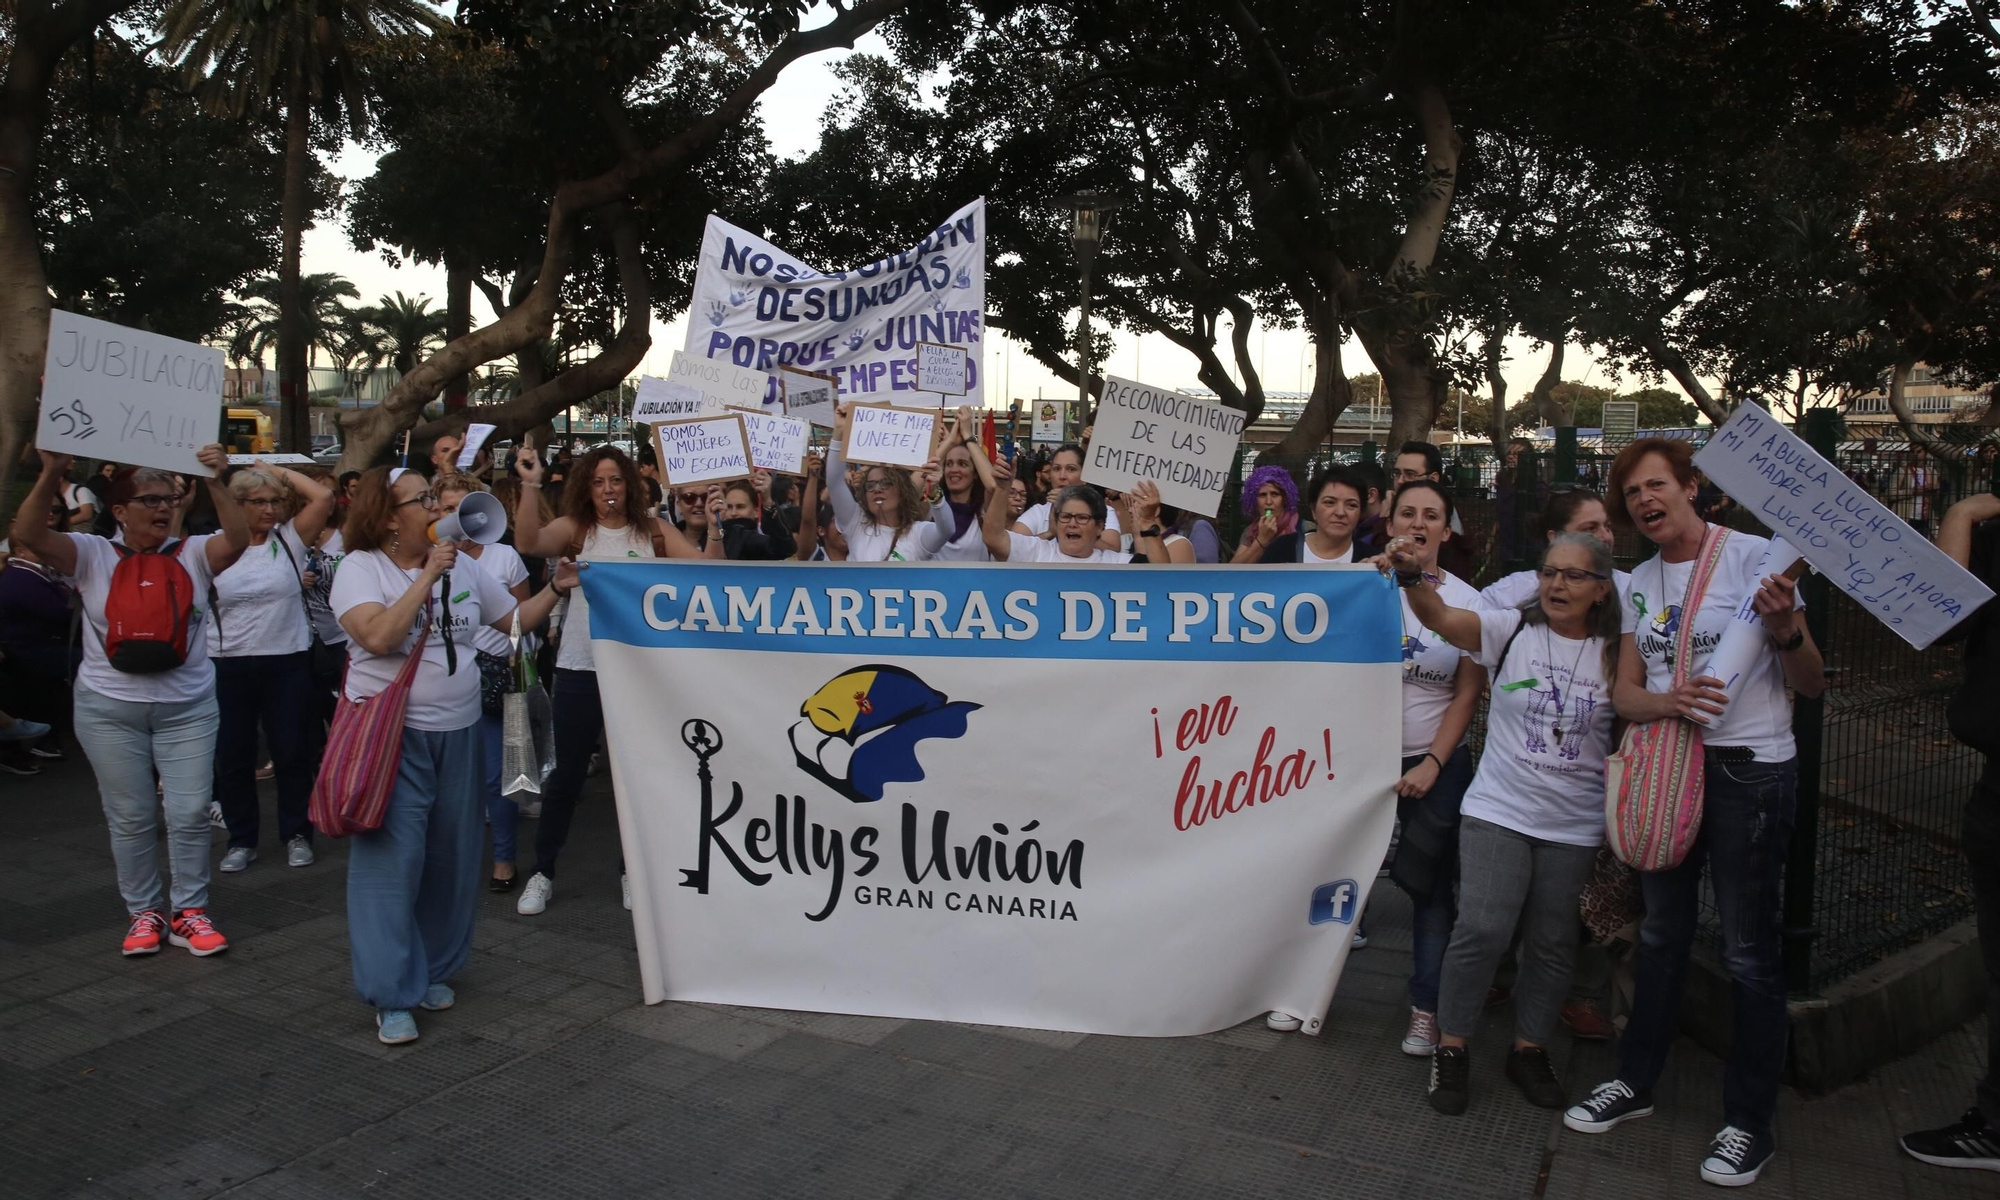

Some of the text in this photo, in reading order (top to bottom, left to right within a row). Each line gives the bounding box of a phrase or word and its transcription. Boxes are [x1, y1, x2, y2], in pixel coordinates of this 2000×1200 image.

[720, 236, 799, 284] NOS
[706, 309, 979, 370] PORQUE JUNTAS
[55, 330, 222, 395] JUBILACIÓN
[49, 398, 93, 436] 58
[638, 399, 682, 415] JUBILACIÓN
[684, 400, 695, 414] YA
[855, 409, 876, 423] NO
[880, 411, 899, 426] ME
[1104, 380, 1246, 436] RECONOCIMIENTO
[661, 424, 705, 442] SOMOS
[676, 435, 731, 455] MUJERES
[769, 434, 785, 449] MI
[780, 421, 802, 437] SIN
[1130, 420, 1207, 455] DE LAS
[668, 457, 685, 472] NO
[766, 450, 781, 460] NO
[1094, 445, 1230, 493] EMFERMEDADES
[1736, 412, 1763, 438] MI
[1761, 433, 1828, 488] ABUELA
[1720, 430, 1962, 619] MI MADRE LUCHO Y AHORA
[1762, 495, 1829, 549] LUCHO
[642, 583, 1330, 644] CAMARERAS DE PISO
[678, 719, 1085, 922] Kellys Unión
[854, 885, 1079, 922] GRAN CANARIA
